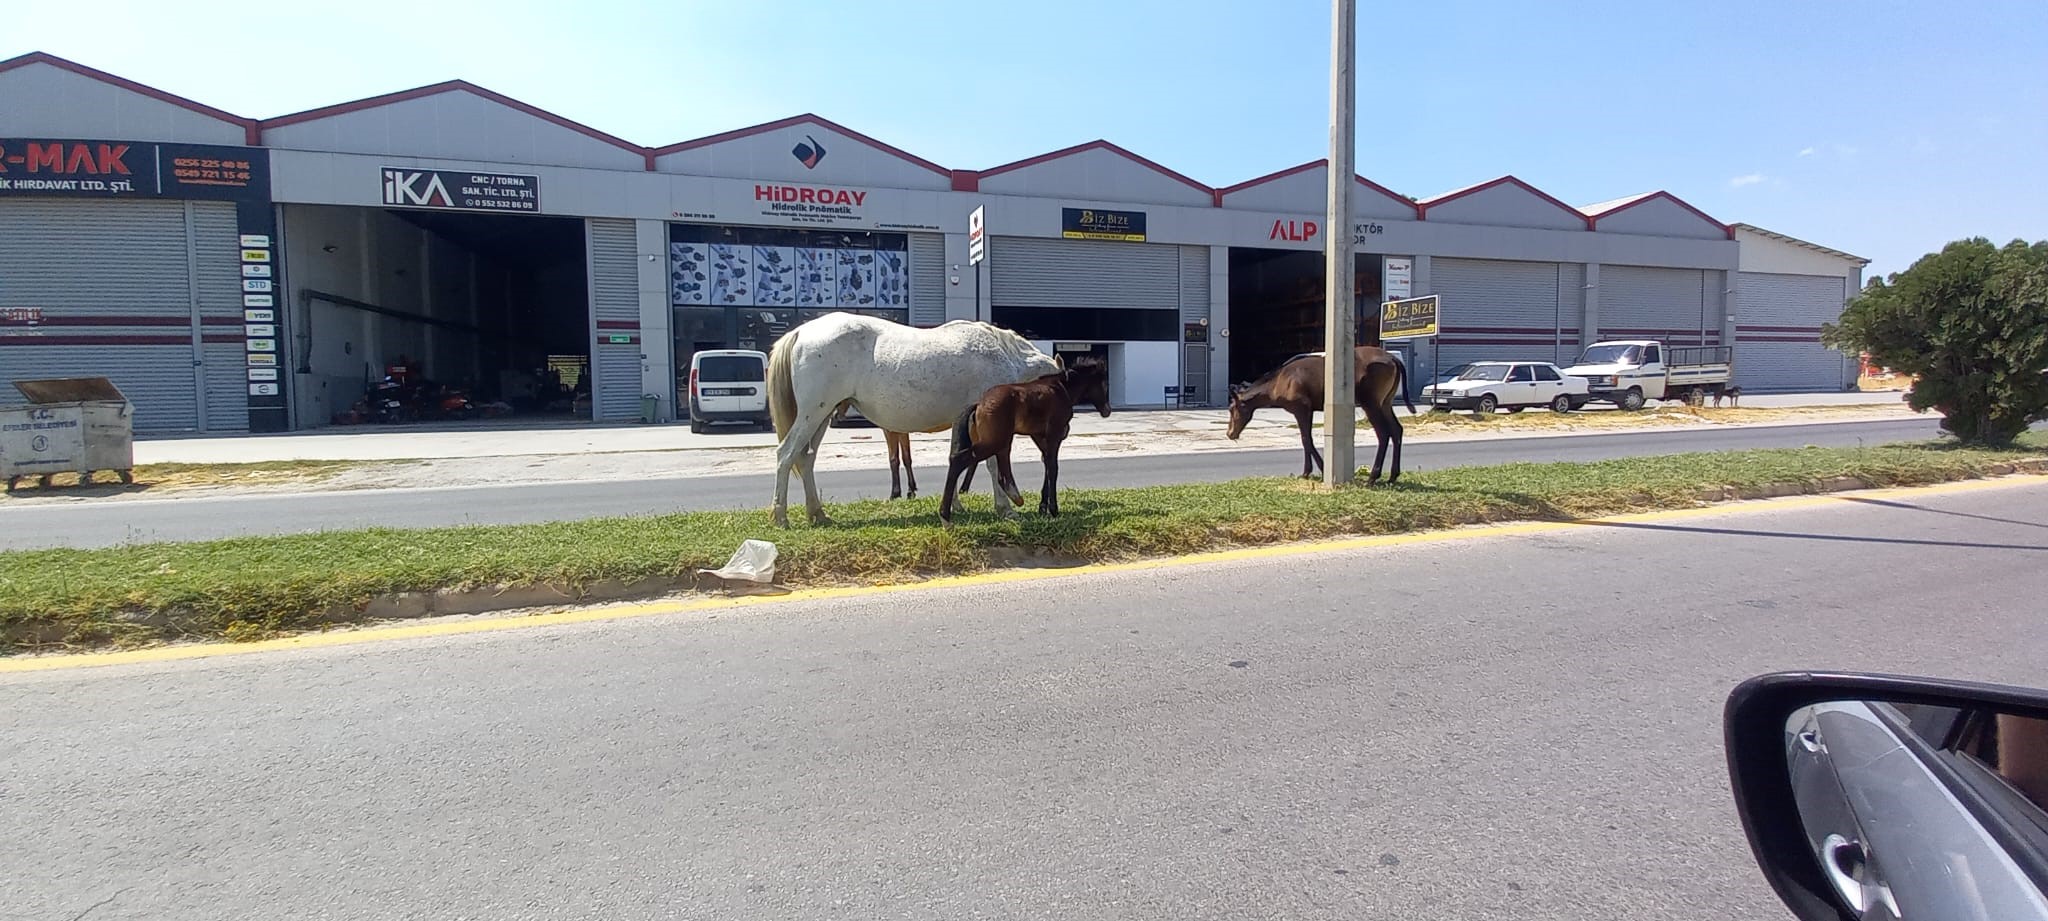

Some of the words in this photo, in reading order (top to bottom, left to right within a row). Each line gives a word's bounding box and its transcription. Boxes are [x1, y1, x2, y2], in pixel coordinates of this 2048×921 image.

[14, 180, 78, 190] HIRDAVAT
[81, 181, 108, 191] LTD.
[110, 179, 135, 193] ŞTİ.
[471, 175, 489, 184] CNC
[496, 177, 525, 186] TORNA
[462, 187, 482, 195] SAN.
[483, 186, 500, 196] TİC.
[501, 188, 518, 197] LTD.
[771, 202, 807, 212] Hidrolik
[809, 205, 852, 214] Pnömatik
[1270, 219, 1318, 241] ALP
[248, 281, 267, 289] STD
